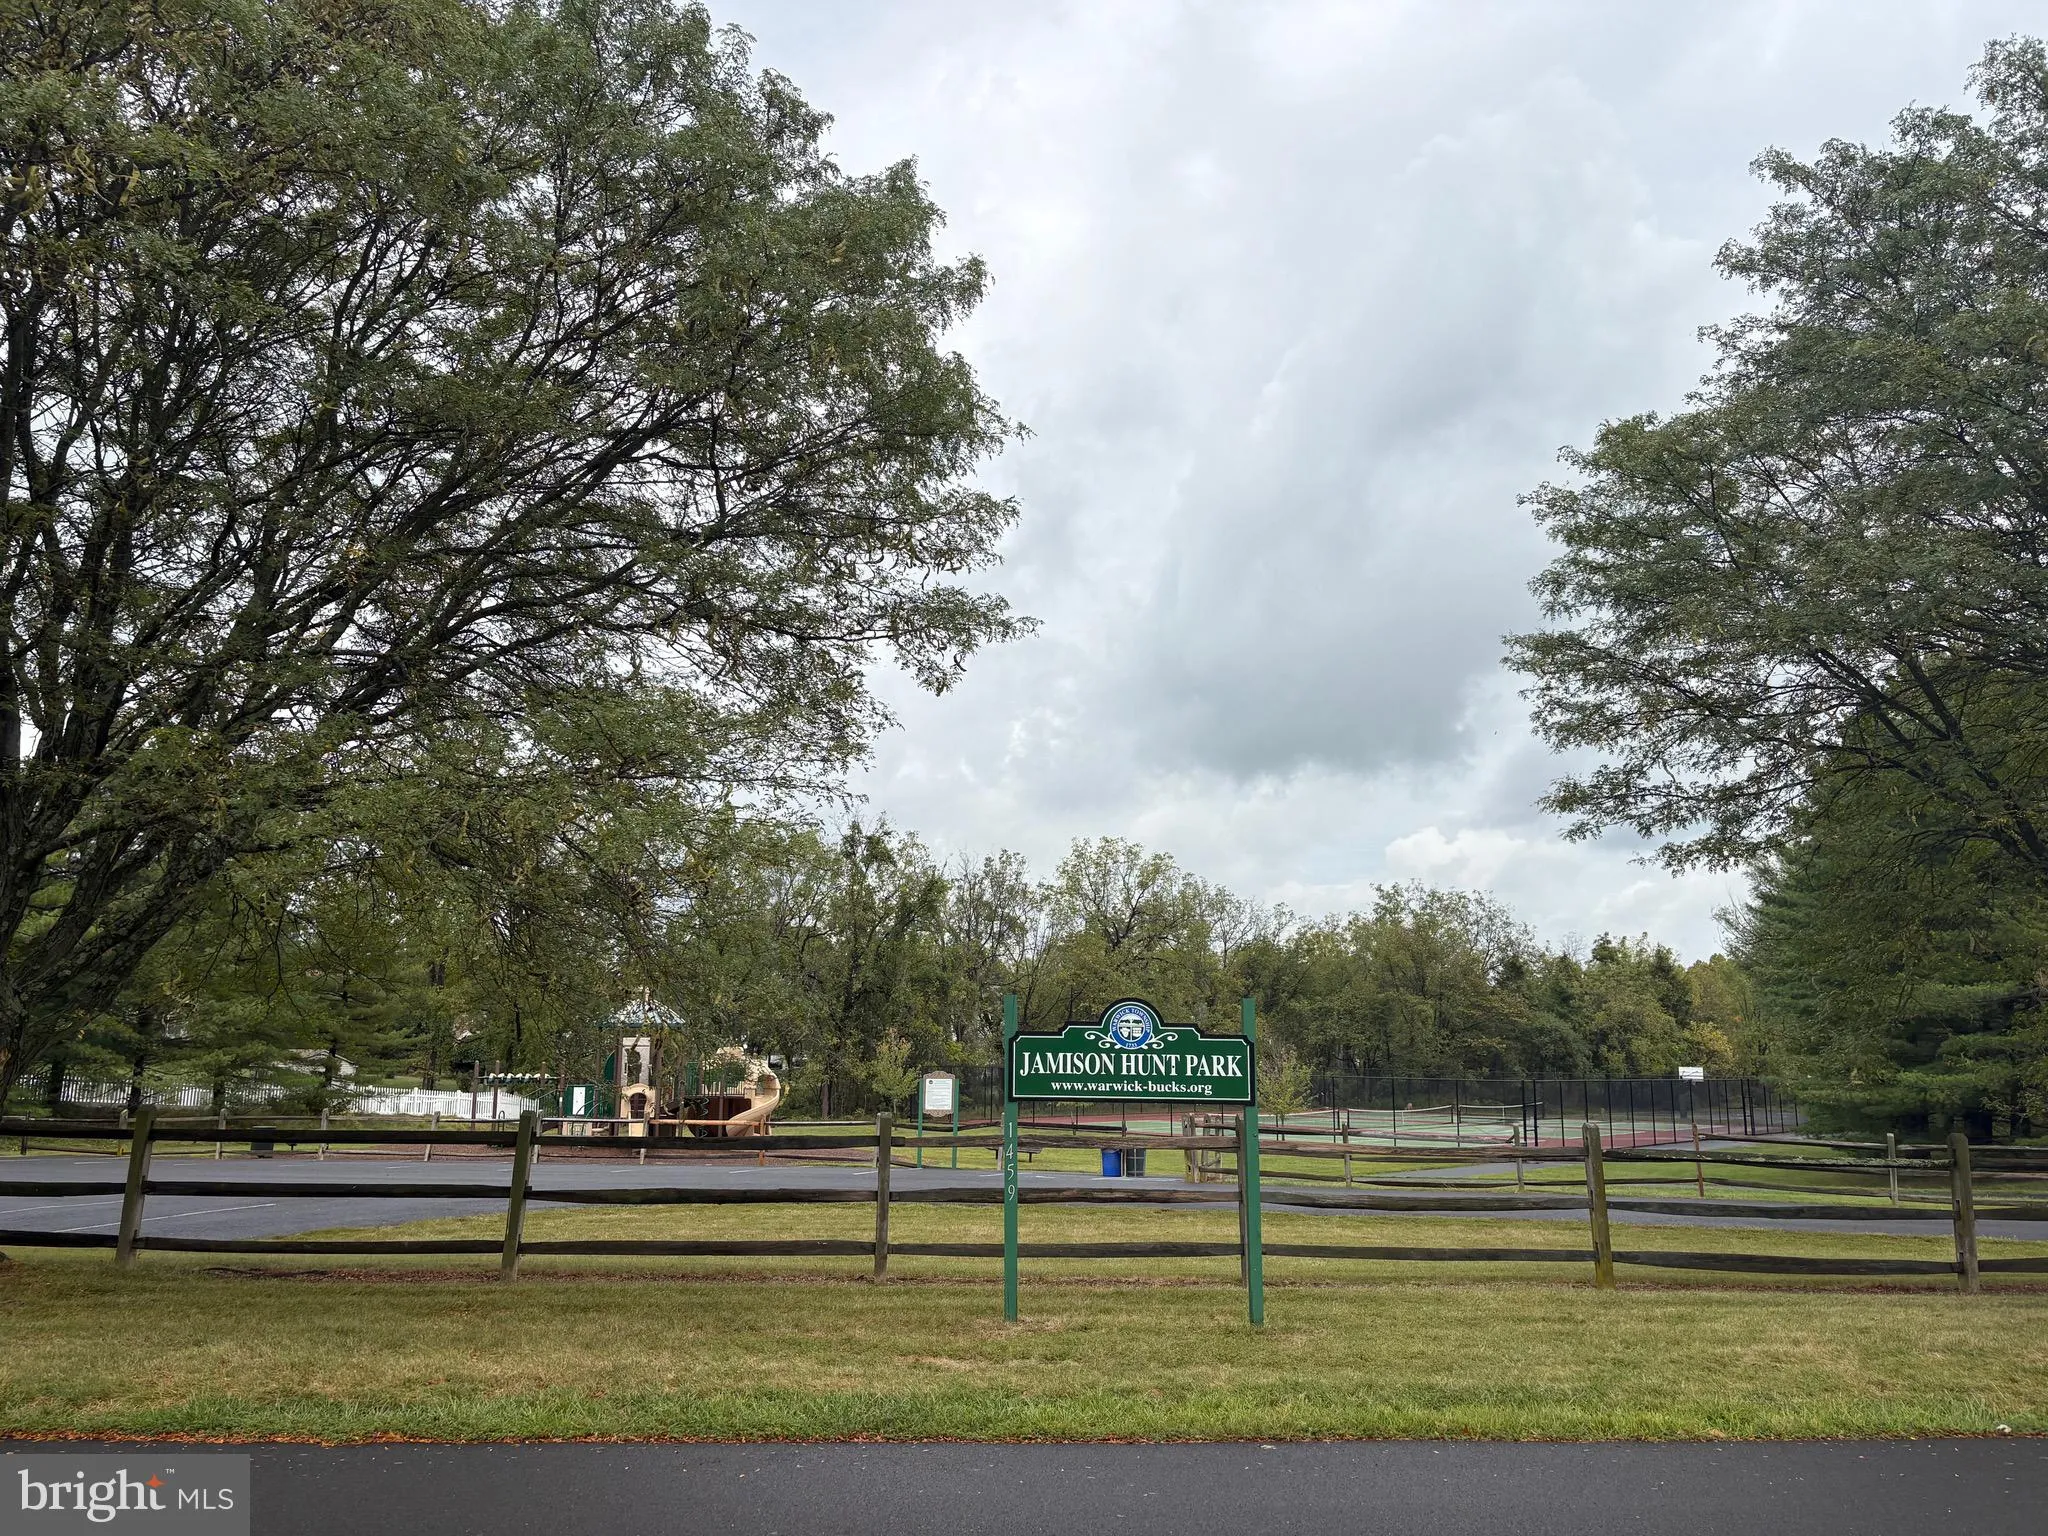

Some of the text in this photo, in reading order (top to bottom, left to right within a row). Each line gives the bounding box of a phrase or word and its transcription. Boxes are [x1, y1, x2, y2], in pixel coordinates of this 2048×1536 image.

[1112, 1009, 1151, 1033] WARWICK TOWNSHIP
[1020, 1051, 1243, 1077] JAMISON HUNT PARK
[1051, 1080, 1213, 1095] www.warwick-bucks.org
[1006, 1122, 1015, 1201] 1459
